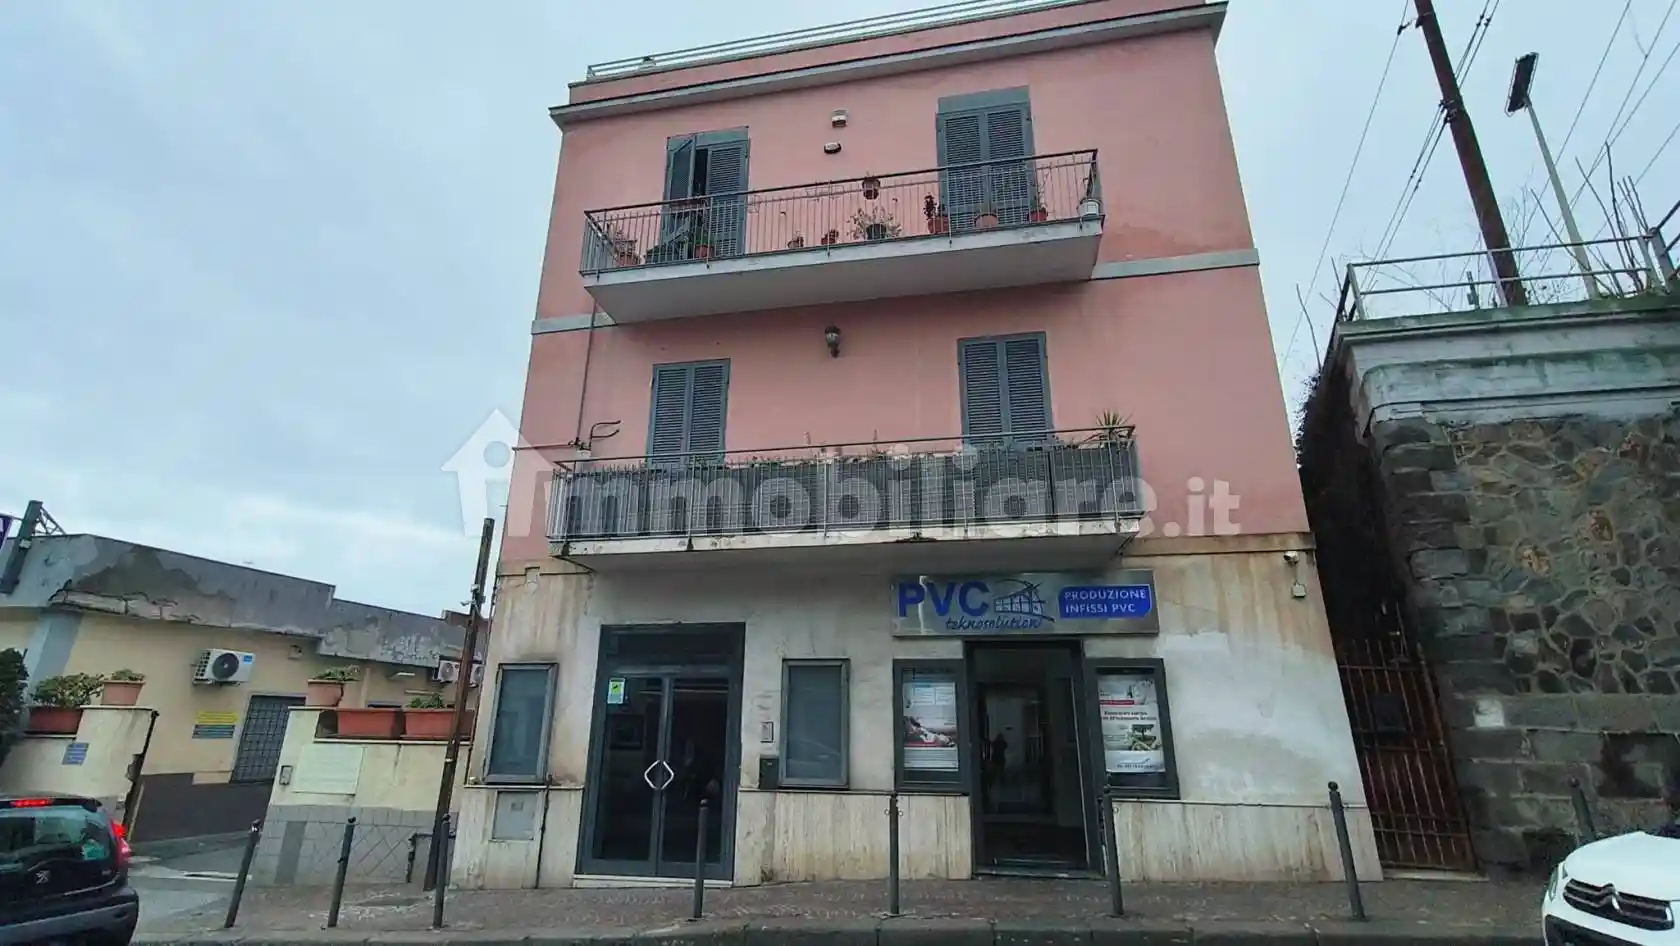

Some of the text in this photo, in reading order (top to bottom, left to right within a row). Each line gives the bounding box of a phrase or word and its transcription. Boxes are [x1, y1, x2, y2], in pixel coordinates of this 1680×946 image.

[898, 580, 989, 617] PVC
[1064, 588, 1147, 602] PRODUZIONE
[1065, 603, 1137, 614] INFISSI PVC
